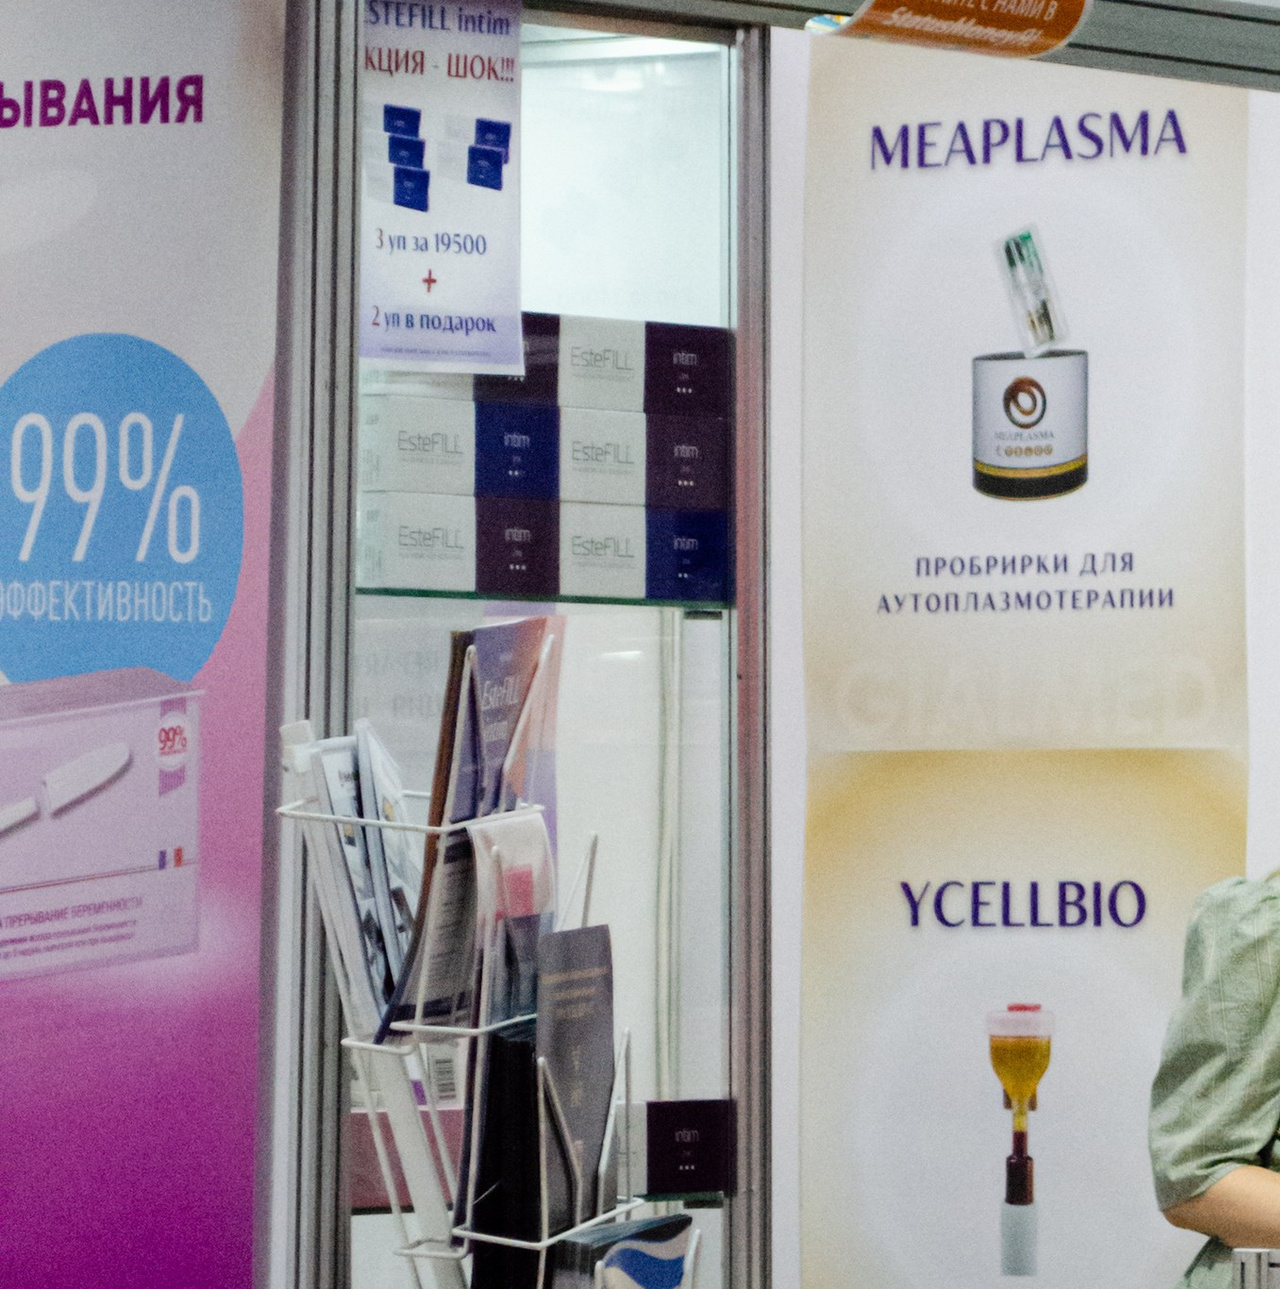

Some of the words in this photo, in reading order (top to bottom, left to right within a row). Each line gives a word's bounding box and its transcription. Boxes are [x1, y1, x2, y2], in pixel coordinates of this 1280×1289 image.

[458, 6, 510, 35] intim
[1044, 0, 1058, 21] В
[447, 53, 515, 82] ШОК!!!
[871, 109, 1187, 170] MEAPLASMA
[376, 228, 384, 249] 3
[388, 234, 406, 255] уп
[412, 236, 428, 252] за
[435, 232, 487, 255] 19500
[372, 305, 380, 326] 2
[384, 312, 400, 332] уп
[405, 314, 414, 329] в
[420, 314, 497, 336] подарок
[398, 431, 464, 455] EsteFILL
[571, 441, 634, 465] EsteFILL
[10, 412, 201, 564] 99%
[399, 525, 464, 549] EsteFILL
[571, 536, 634, 559] EsteFILL
[916, 554, 1068, 577] ПРОБРИРКИ
[1079, 552, 1134, 576] ДЛЯ
[877, 587, 1174, 613] АУТОПЛАЗМОТЕРАПИИ
[900, 879, 1147, 929] YCELLBIO
